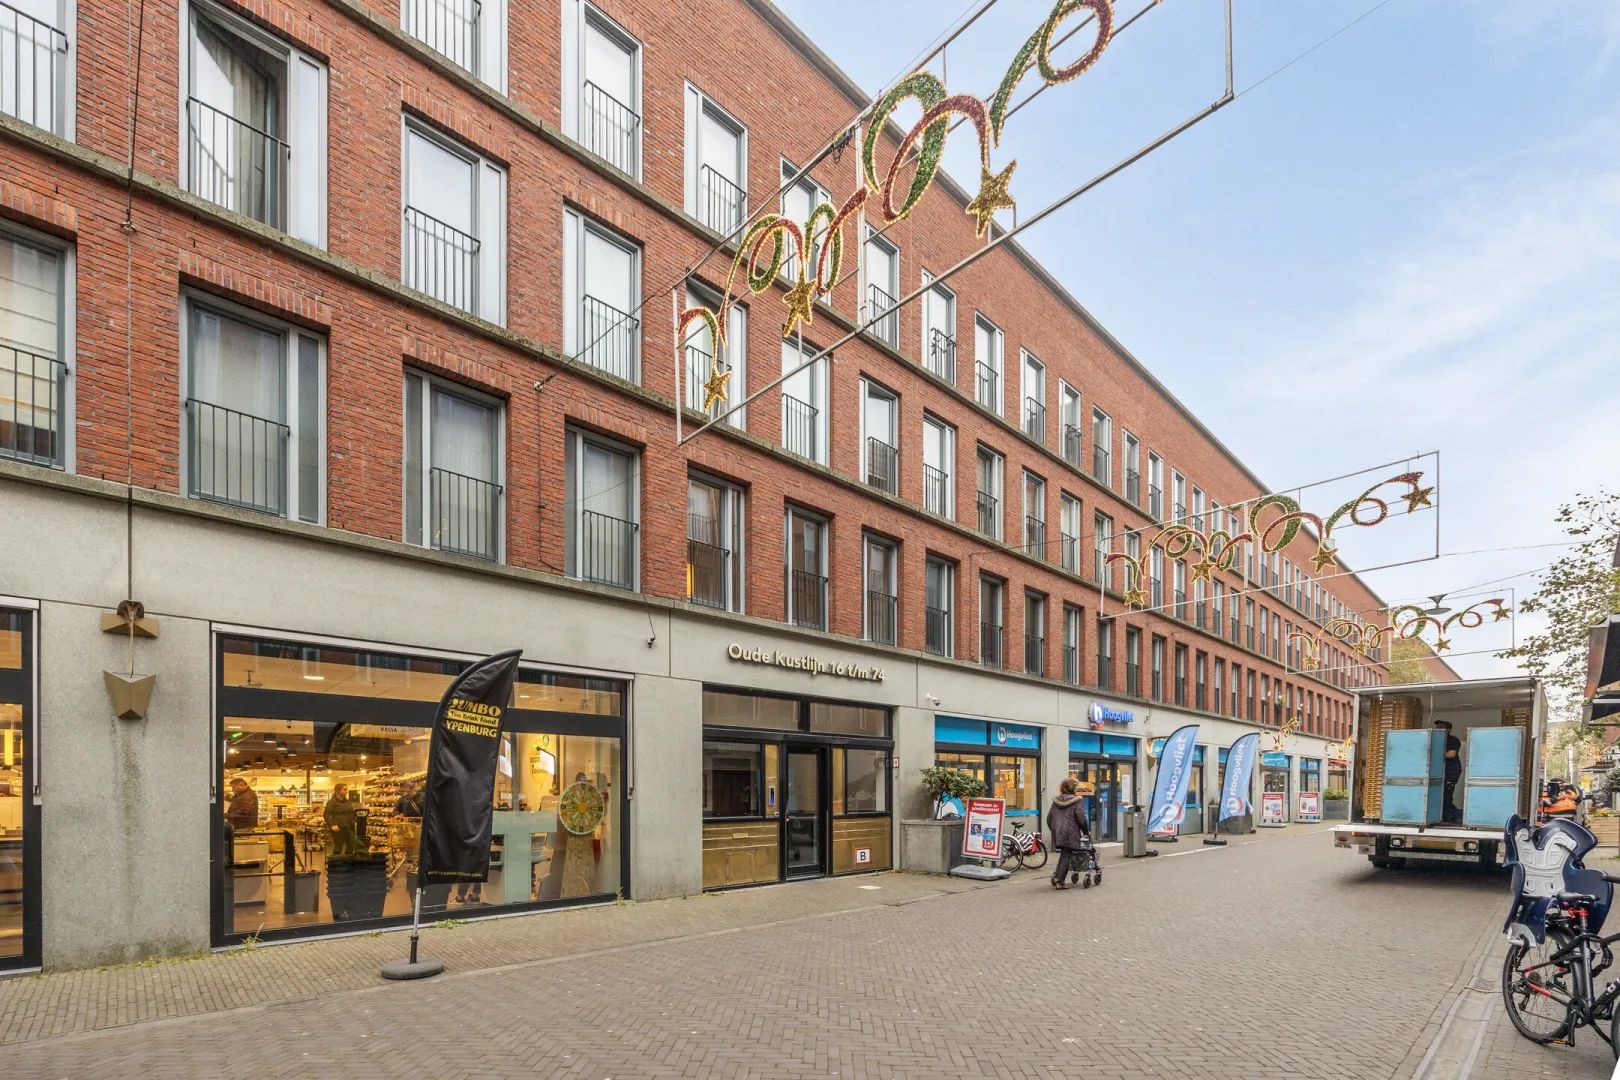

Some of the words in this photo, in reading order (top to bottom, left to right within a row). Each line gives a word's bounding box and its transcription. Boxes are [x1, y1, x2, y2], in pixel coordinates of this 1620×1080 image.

[728, 643, 770, 664] Oude
[774, 650, 825, 675] Kustlijn
[829, 661, 845, 675] 16
[848, 664, 869, 679] t/m
[872, 668, 885, 682] 74
[450, 698, 501, 717] JUMBO
[450, 710, 462, 719] Ten
[463, 713, 479, 722] Brink
[480, 717, 497, 725] Food
[446, 719, 498, 738] YPENBURG
[1006, 730, 1033, 741] Hoogvliet
[1166, 737, 1186, 801] Hoogvliet
[1229, 743, 1246, 796] Hoogvliet
[860, 851, 867, 861] B
